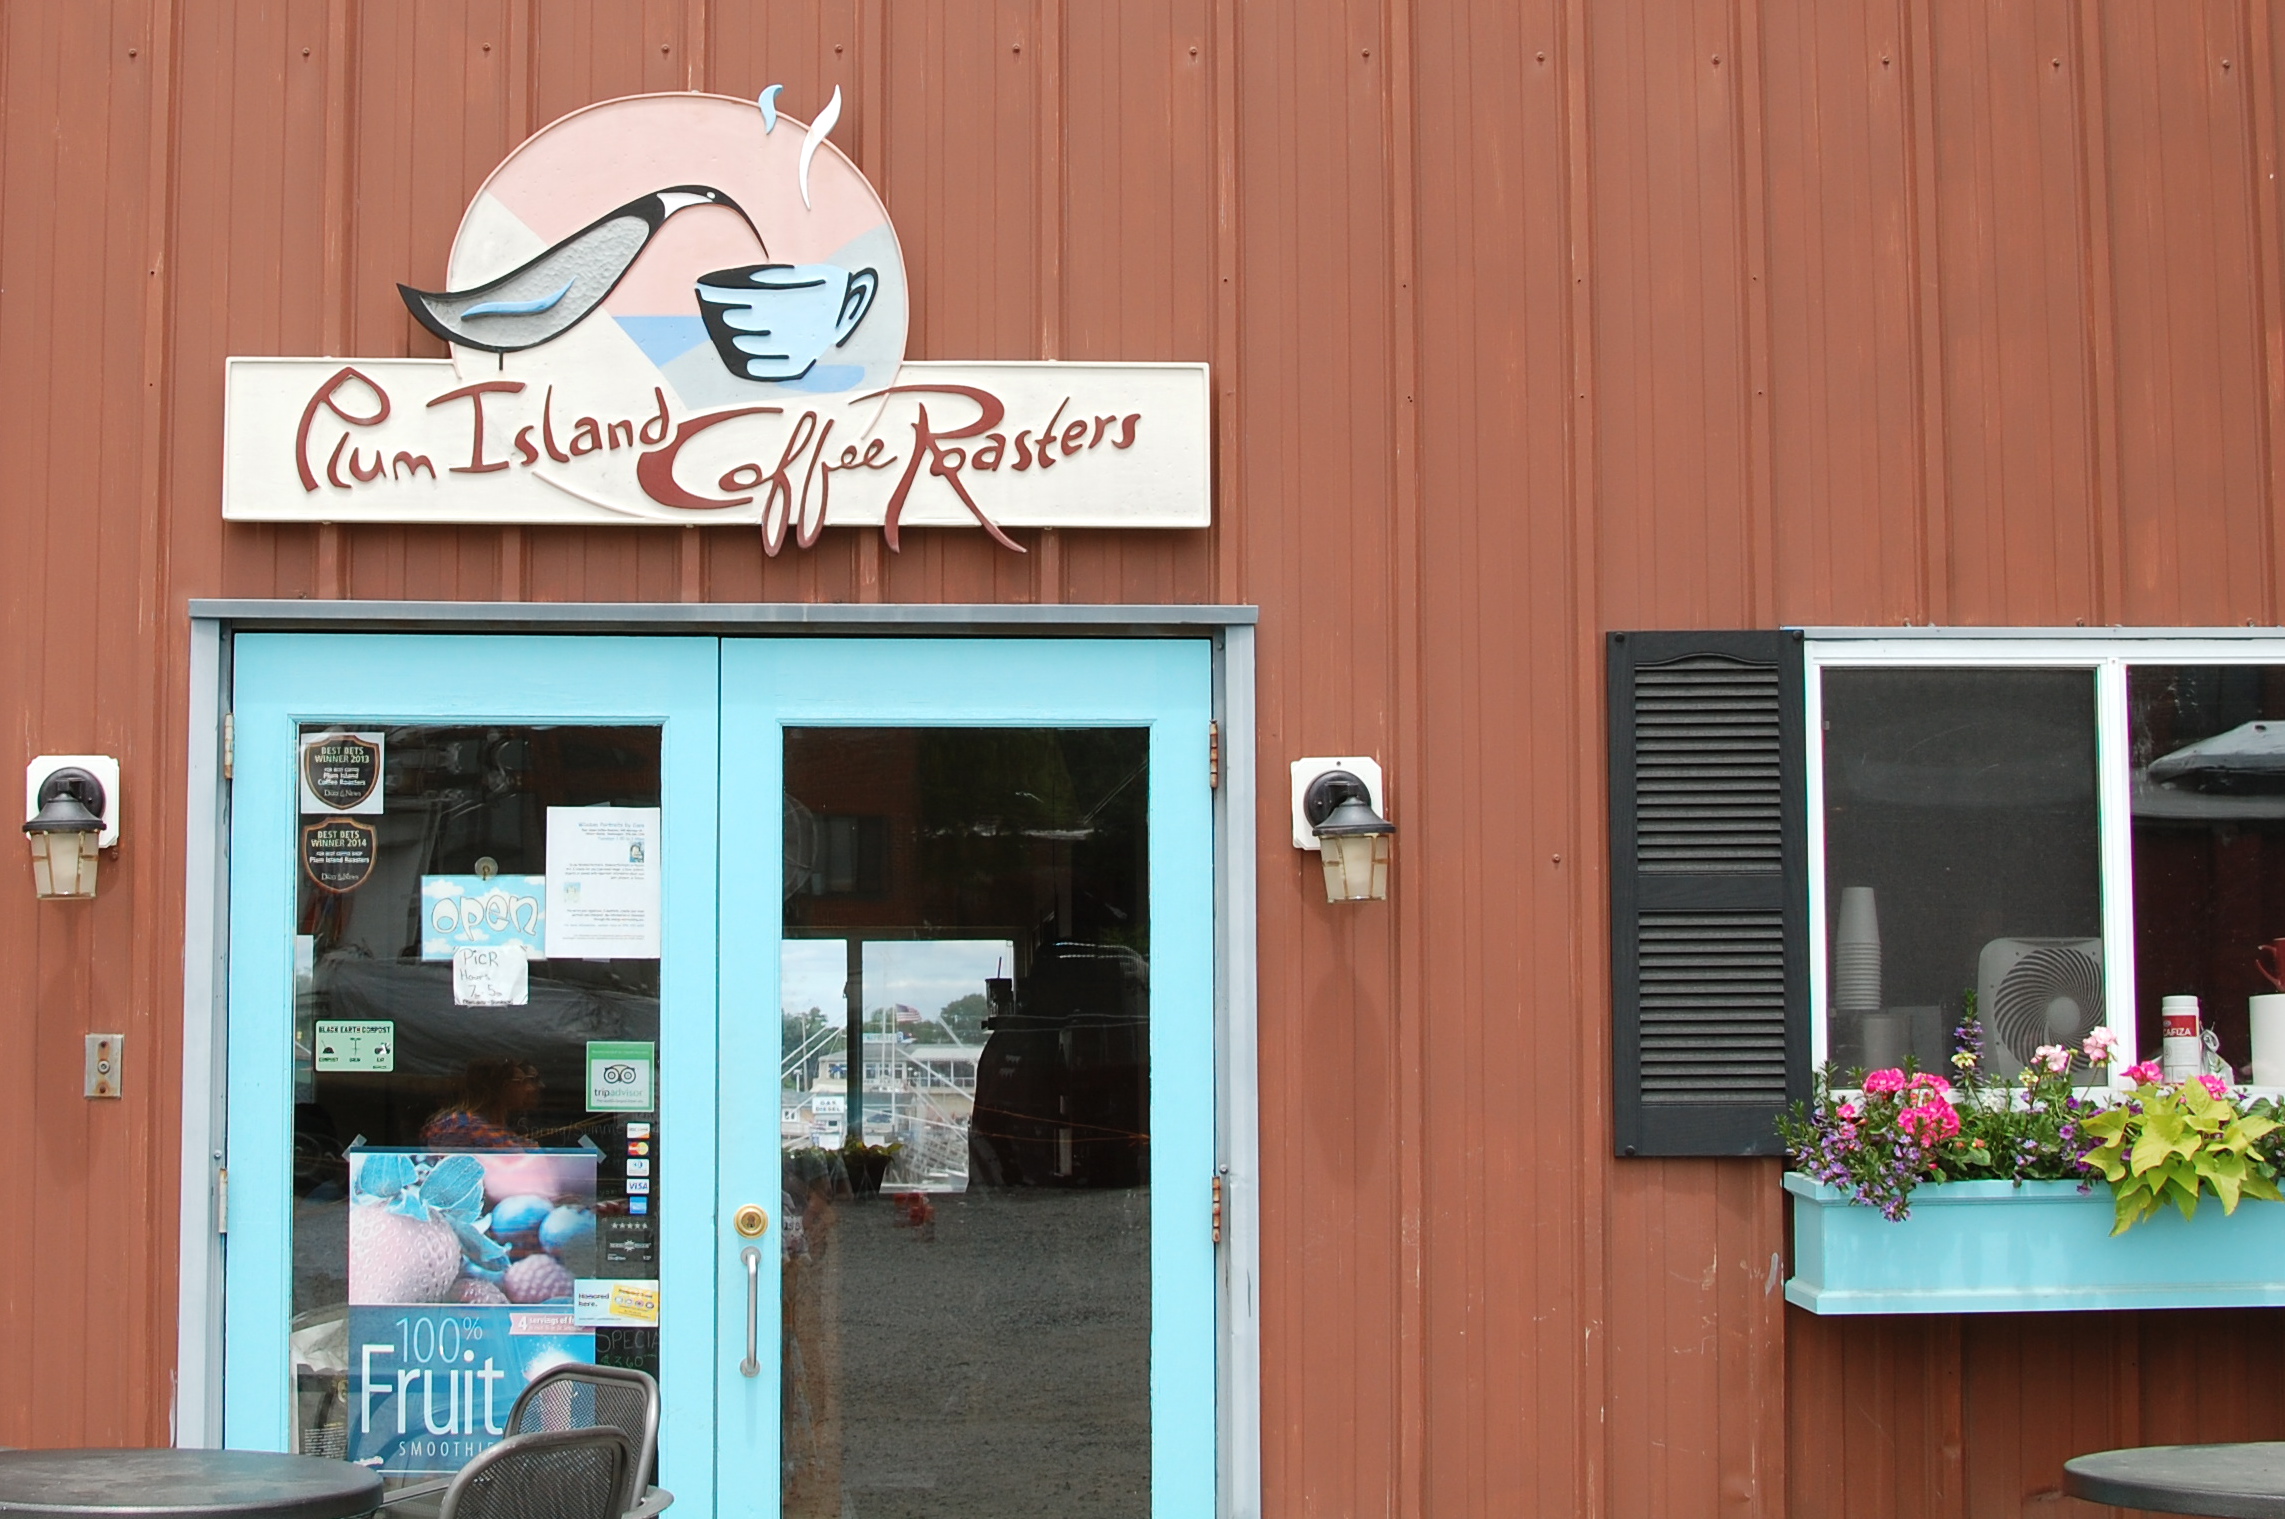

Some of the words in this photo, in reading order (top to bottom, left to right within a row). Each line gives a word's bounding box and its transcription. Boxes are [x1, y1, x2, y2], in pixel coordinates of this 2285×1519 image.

[295, 366, 437, 492] Plum
[425, 380, 670, 474] Island
[637, 407, 898, 557] Coffee
[848, 384, 1142, 554] Roasters
[321, 746, 341, 755] BEST
[344, 746, 364, 755] BETS
[314, 755, 349, 763] WINNER
[350, 755, 370, 763] 2013
[317, 830, 337, 839] BEST
[340, 830, 360, 839] BETS
[311, 838, 345, 847] WINNER
[347, 838, 367, 847] 2014
[594, 1088, 643, 1098] tripadvisor
[629, 1182, 649, 1190] VISA
[518, 1316, 528, 1331] 4
[396, 1316, 483, 1364] 100%
[361, 1343, 505, 1436] Fruit
